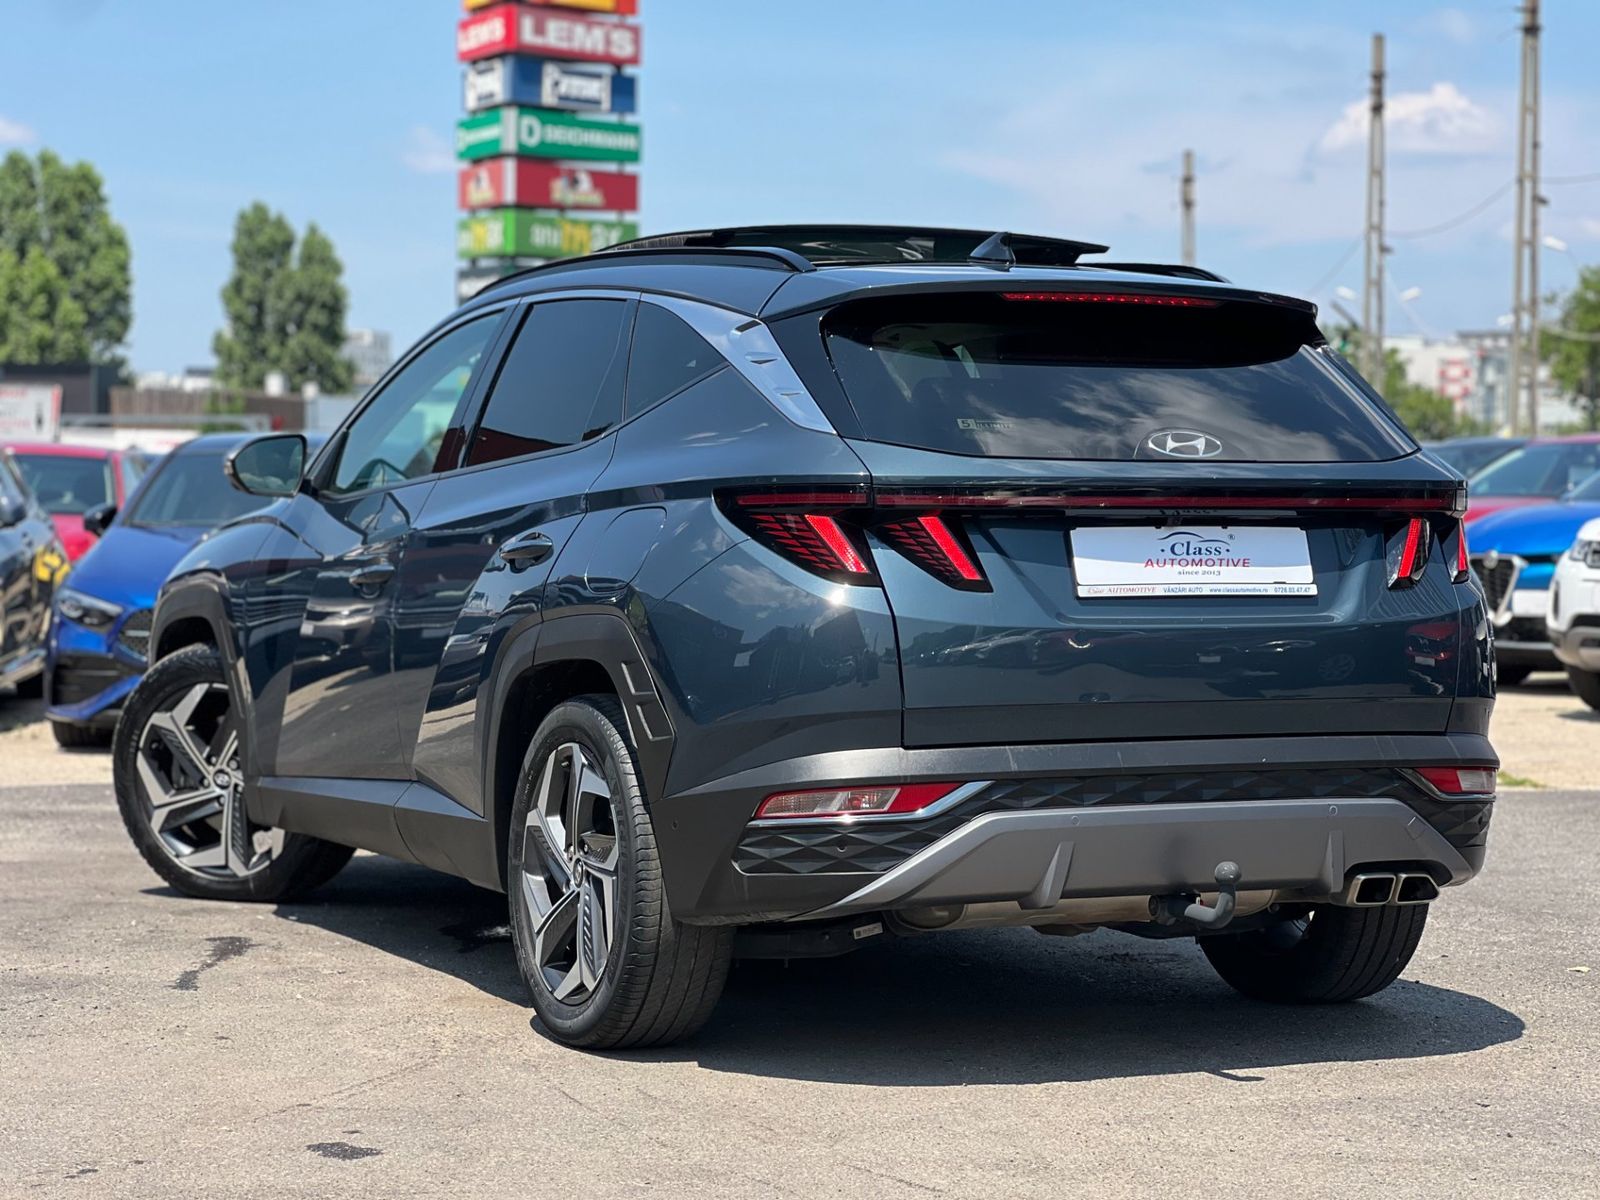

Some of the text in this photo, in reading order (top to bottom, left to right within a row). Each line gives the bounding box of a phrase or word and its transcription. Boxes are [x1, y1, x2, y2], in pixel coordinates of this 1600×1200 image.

[1170, 541, 1222, 556] Class
[1144, 558, 1251, 568] AUTOMOTIVE
[1107, 586, 1157, 594] AUTOMOTIVE
